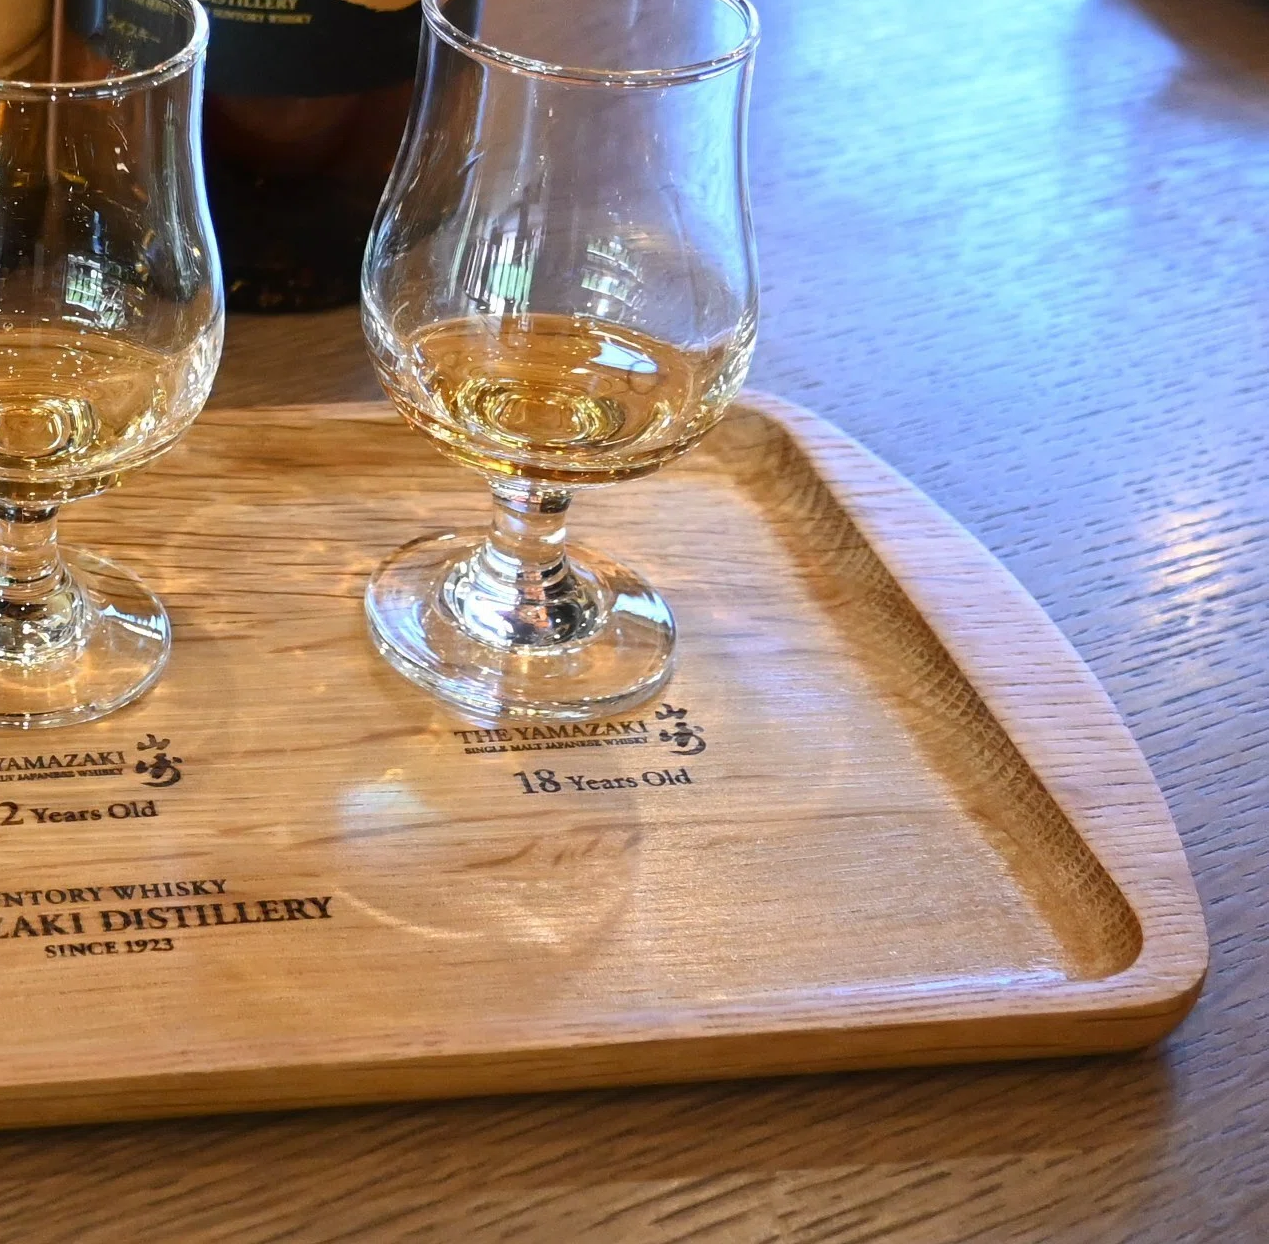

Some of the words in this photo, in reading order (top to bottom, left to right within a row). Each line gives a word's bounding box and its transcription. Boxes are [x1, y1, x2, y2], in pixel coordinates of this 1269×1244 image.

[454, 729, 514, 744] THE
[513, 720, 649, 741] YAMAZAKI
[464, 745, 508, 755] SINGLE
[511, 742, 543, 752] MALT
[545, 739, 601, 750] JAPANESE
[603, 736, 648, 746] WHISKY
[17, 770, 75, 781] JAPANESE
[77, 767, 123, 778] WHISKY
[513, 769, 562, 795] 18
[567, 774, 638, 792] Years
[642, 768, 693, 787] Old
[31, 806, 102, 824] Years
[108, 800, 159, 819] Old
[112, 879, 227, 900] WHISKY
[100, 896, 333, 933] DISTILLERY
[44, 940, 118, 959] SINCE
[125, 937, 175, 954] 1923
